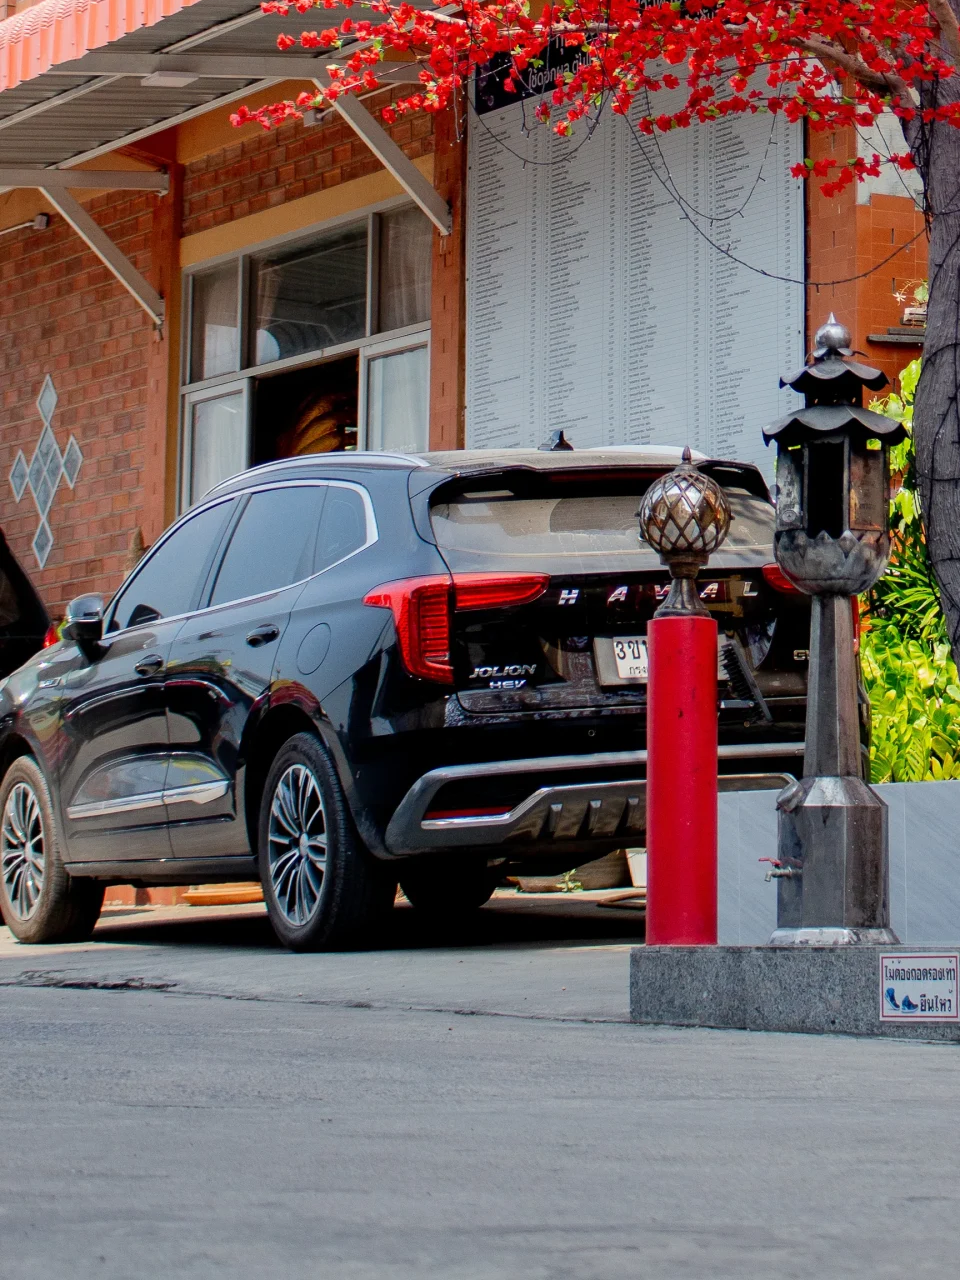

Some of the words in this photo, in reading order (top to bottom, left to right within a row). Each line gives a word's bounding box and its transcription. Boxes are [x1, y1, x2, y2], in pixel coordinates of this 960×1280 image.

[558, 581, 758, 605] HAVAL
[469, 663, 537, 679] JOLION
[489, 679, 527, 689] HEV
[884, 959, 956, 981] ไม่ต้องถอดรองเท้า
[920, 988, 953, 1012] ยืนไหว้
